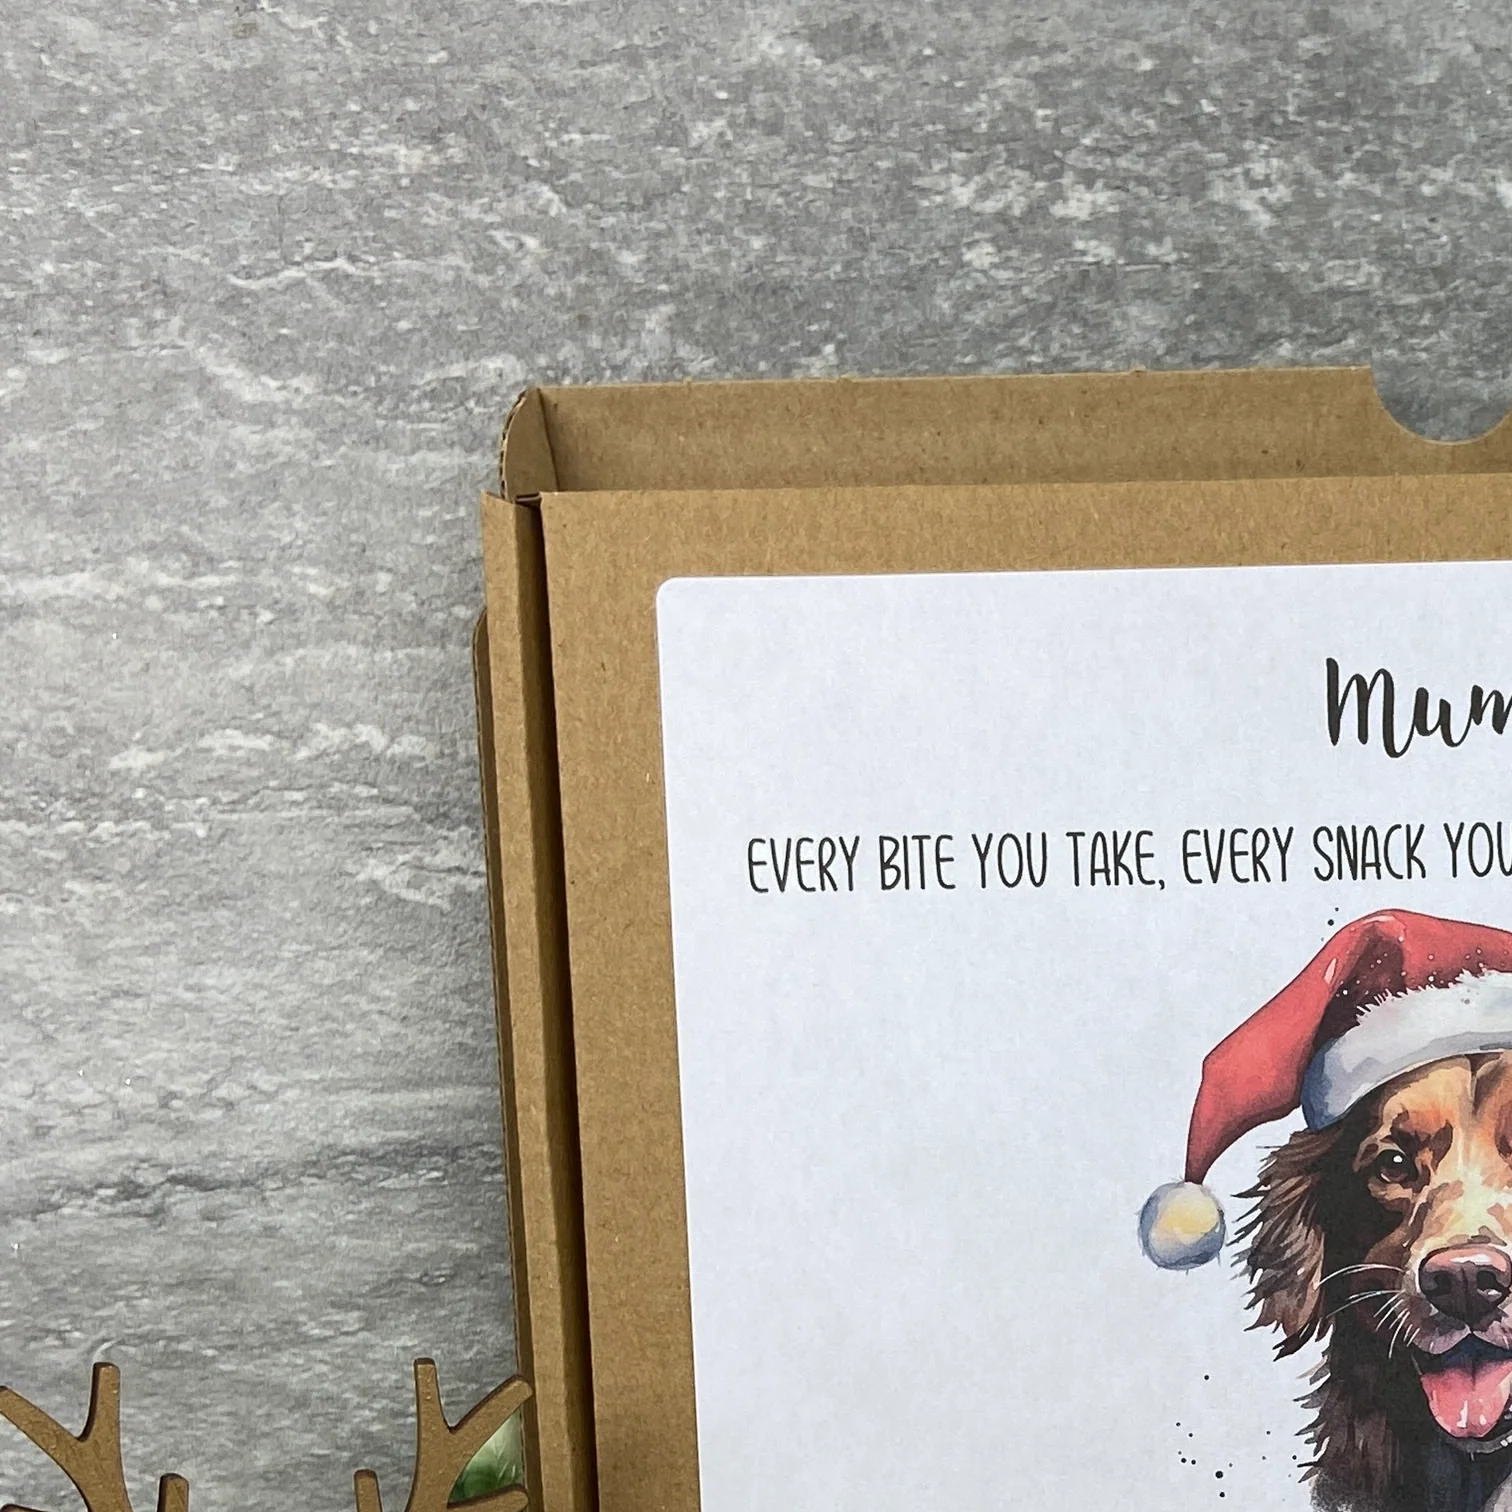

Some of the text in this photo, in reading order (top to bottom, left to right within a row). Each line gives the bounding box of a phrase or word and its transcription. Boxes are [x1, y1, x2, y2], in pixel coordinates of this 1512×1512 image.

[748, 836, 859, 892] EVERY
[879, 835, 955, 890] BITE
[972, 832, 1047, 888] YOU
[1066, 831, 1164, 889] TAKE,
[1183, 827, 1293, 883] EVERY
[1313, 824, 1426, 881] SNACK
